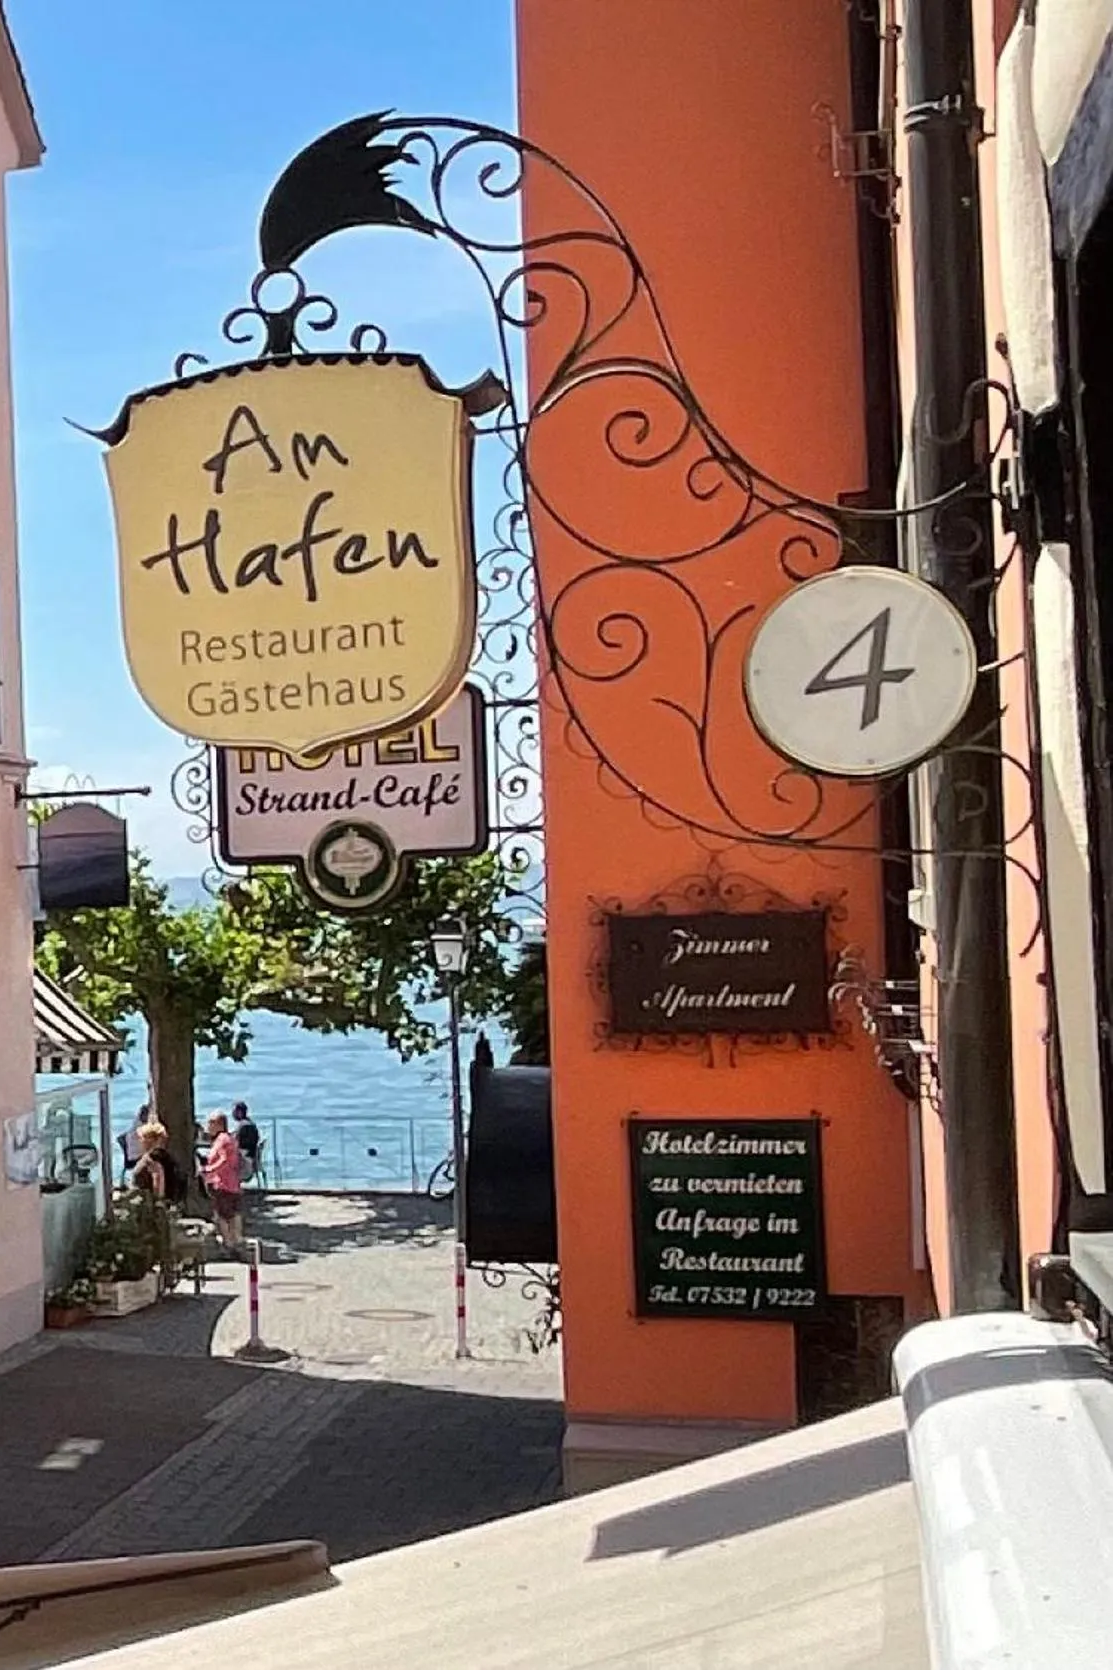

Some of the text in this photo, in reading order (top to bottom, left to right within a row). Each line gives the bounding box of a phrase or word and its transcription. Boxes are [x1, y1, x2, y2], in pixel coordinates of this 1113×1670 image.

[202, 404, 349, 495] Am
[140, 490, 440, 603] Hafen
[180, 615, 406, 666] Restaurant
[803, 606, 916, 732] 4
[186, 672, 406, 719] Gästehaus
[235, 772, 462, 817] Strand-Café
[663, 928, 770, 965] Zimmer
[641, 983, 796, 1018] Apartment
[642, 1130, 807, 1155] Hotelzimmer
[648, 1172, 805, 1195] zu vermieten
[655, 1207, 800, 1239] Anfrage im
[659, 1246, 805, 1273] Restaurant
[687, 1286, 748, 1304] 07532
[766, 1288, 817, 1306] 9222
